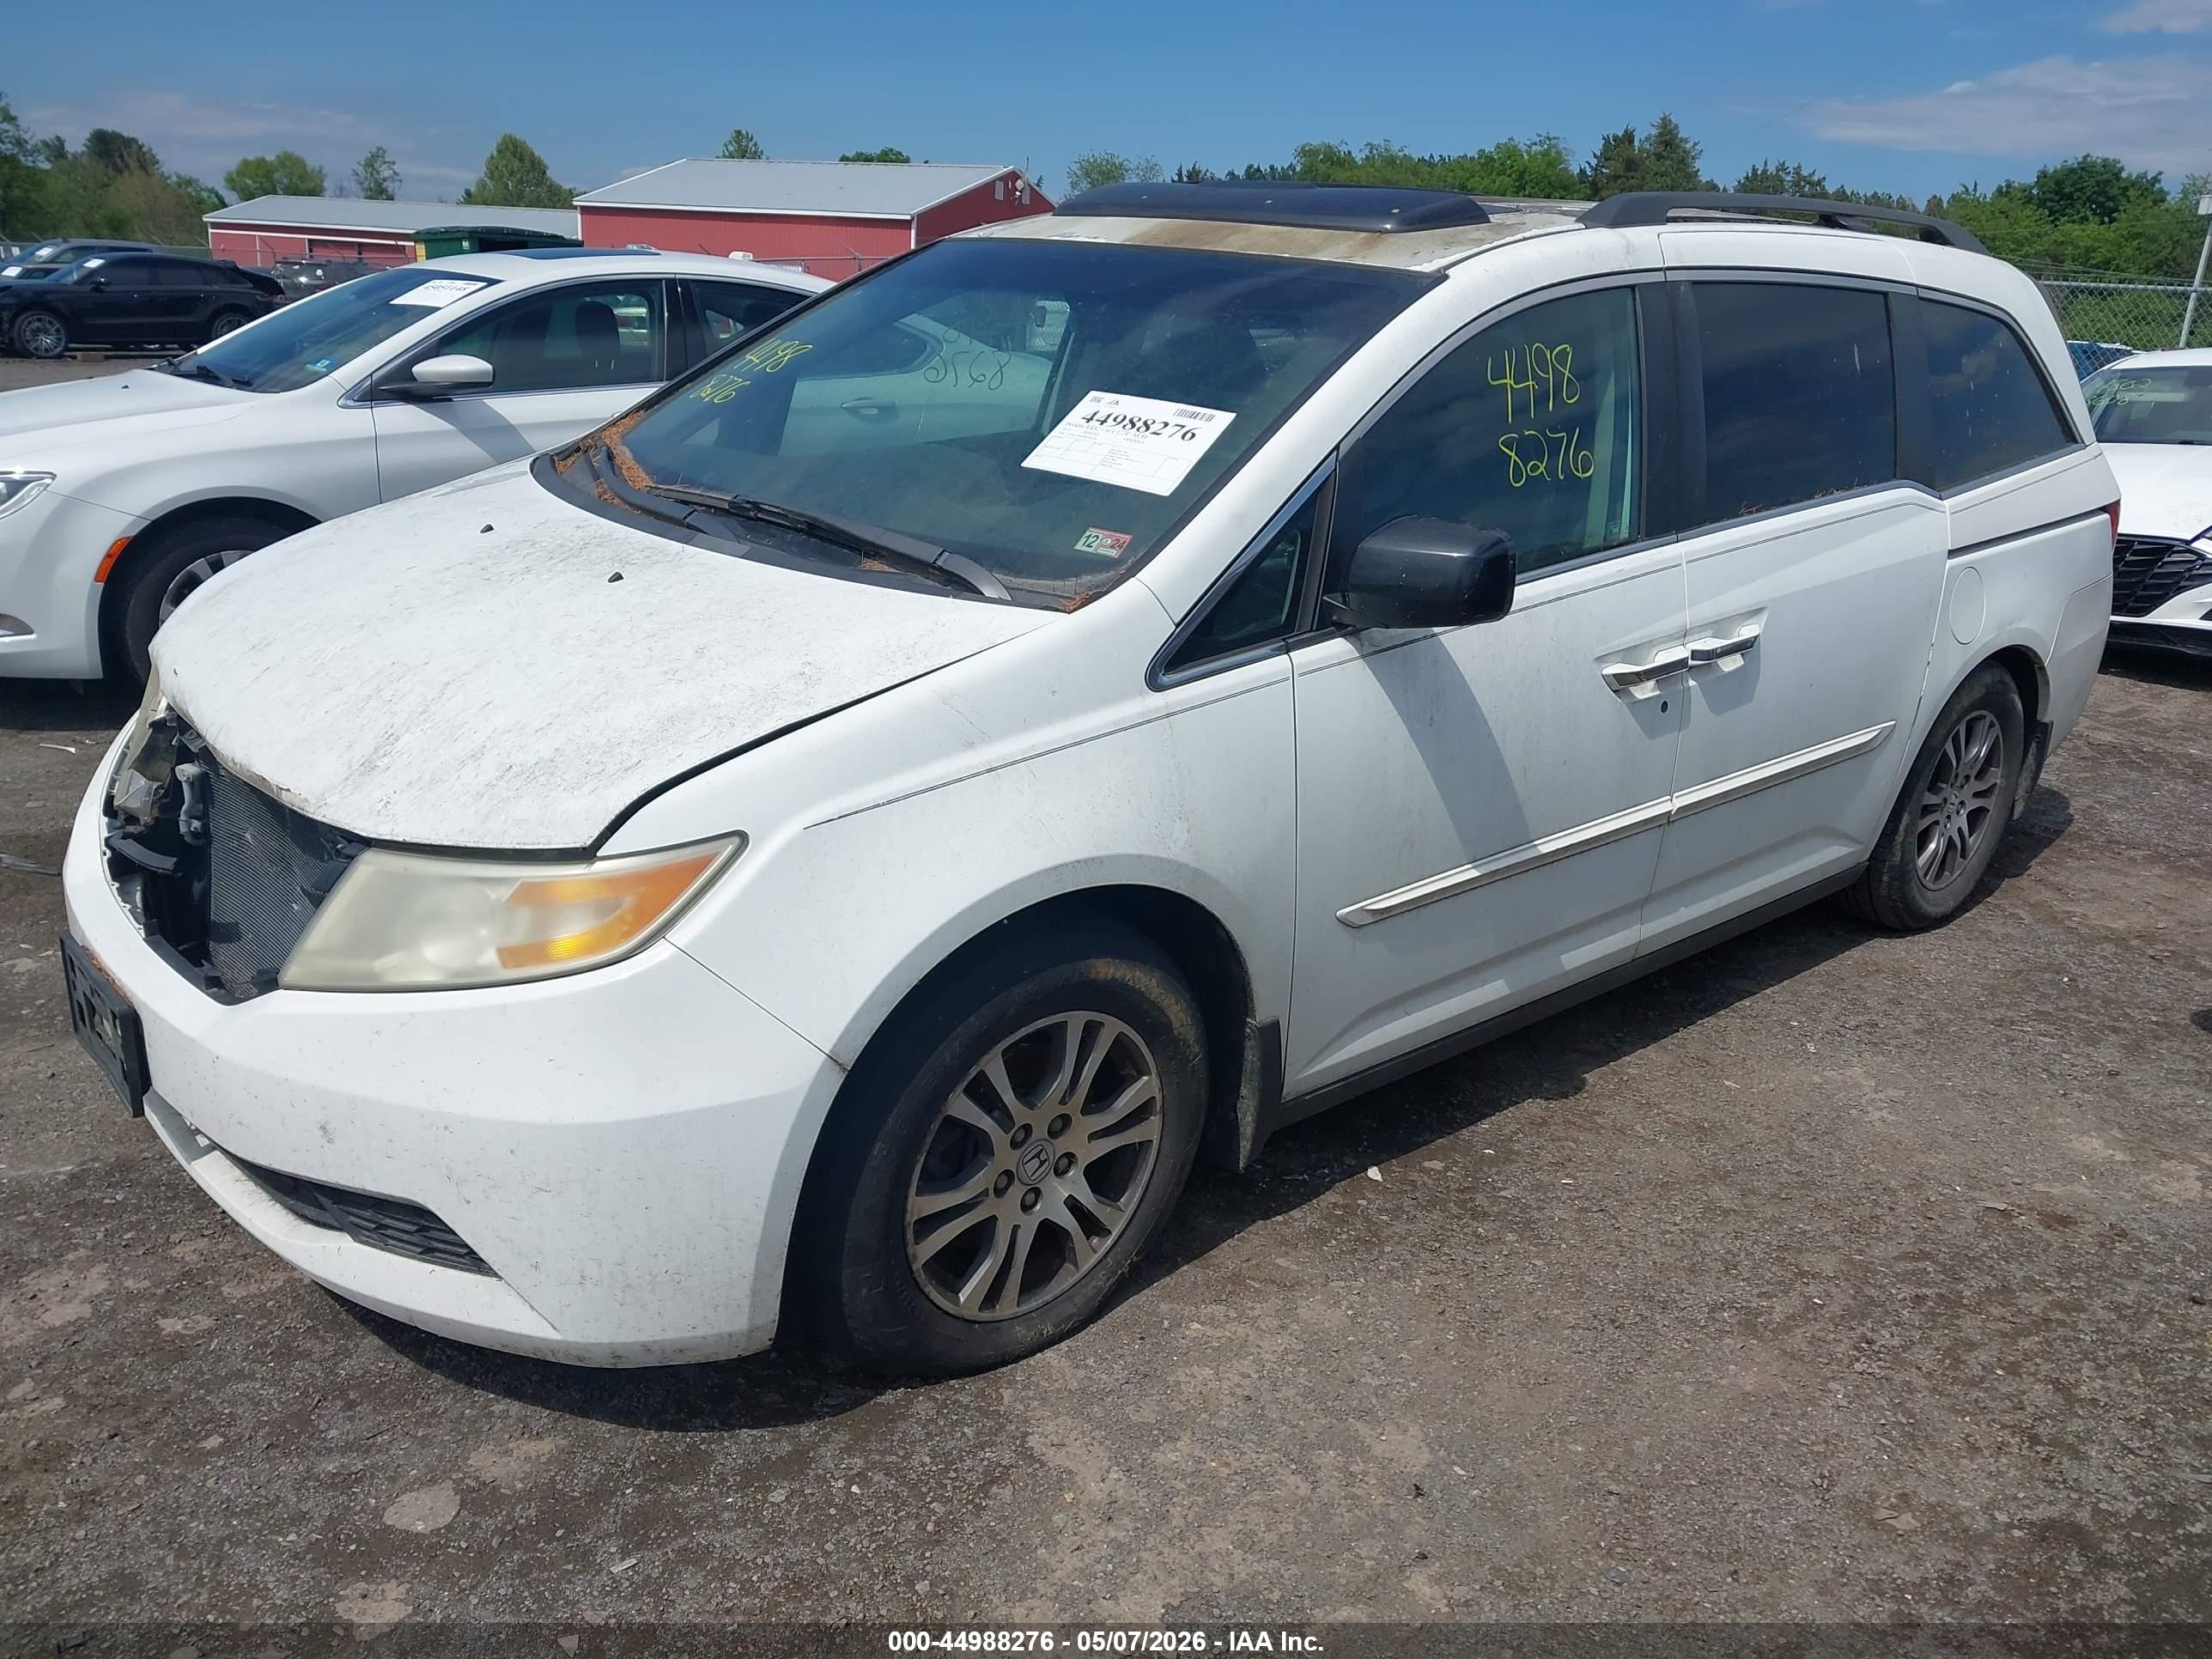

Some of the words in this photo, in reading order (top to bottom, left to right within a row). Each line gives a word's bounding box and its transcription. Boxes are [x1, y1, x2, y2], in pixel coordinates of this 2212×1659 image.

[733, 338, 813, 373] 4498
[1487, 343, 1581, 424] 4498
[1081, 409, 1203, 442] 44988276
[1498, 426, 1595, 487] 8276
[1082, 533, 1100, 549] 12
[1110, 538, 1127, 550] 24
